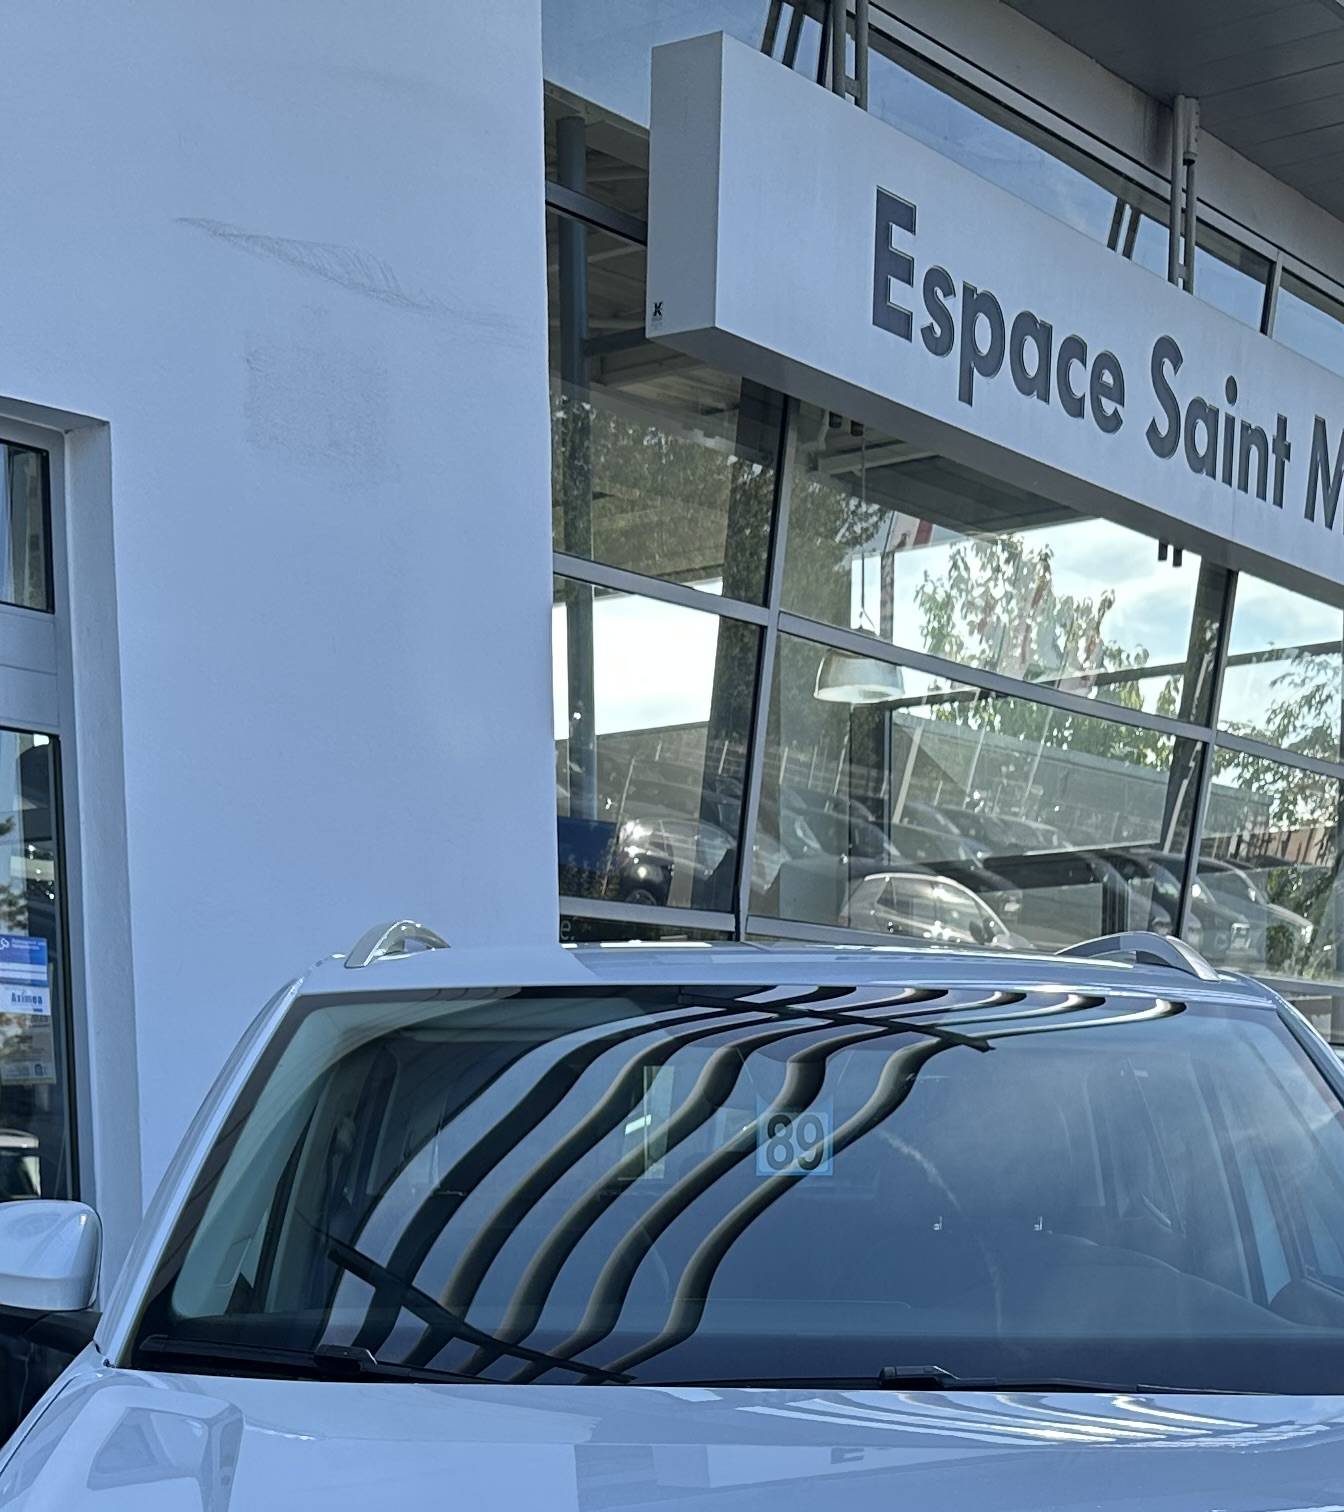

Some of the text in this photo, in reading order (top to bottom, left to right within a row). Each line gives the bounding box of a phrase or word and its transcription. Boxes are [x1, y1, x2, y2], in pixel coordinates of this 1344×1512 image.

[872, 186, 1125, 434] Espace
[1146, 335, 1291, 509] Saint
[767, 1113, 824, 1172] 89
